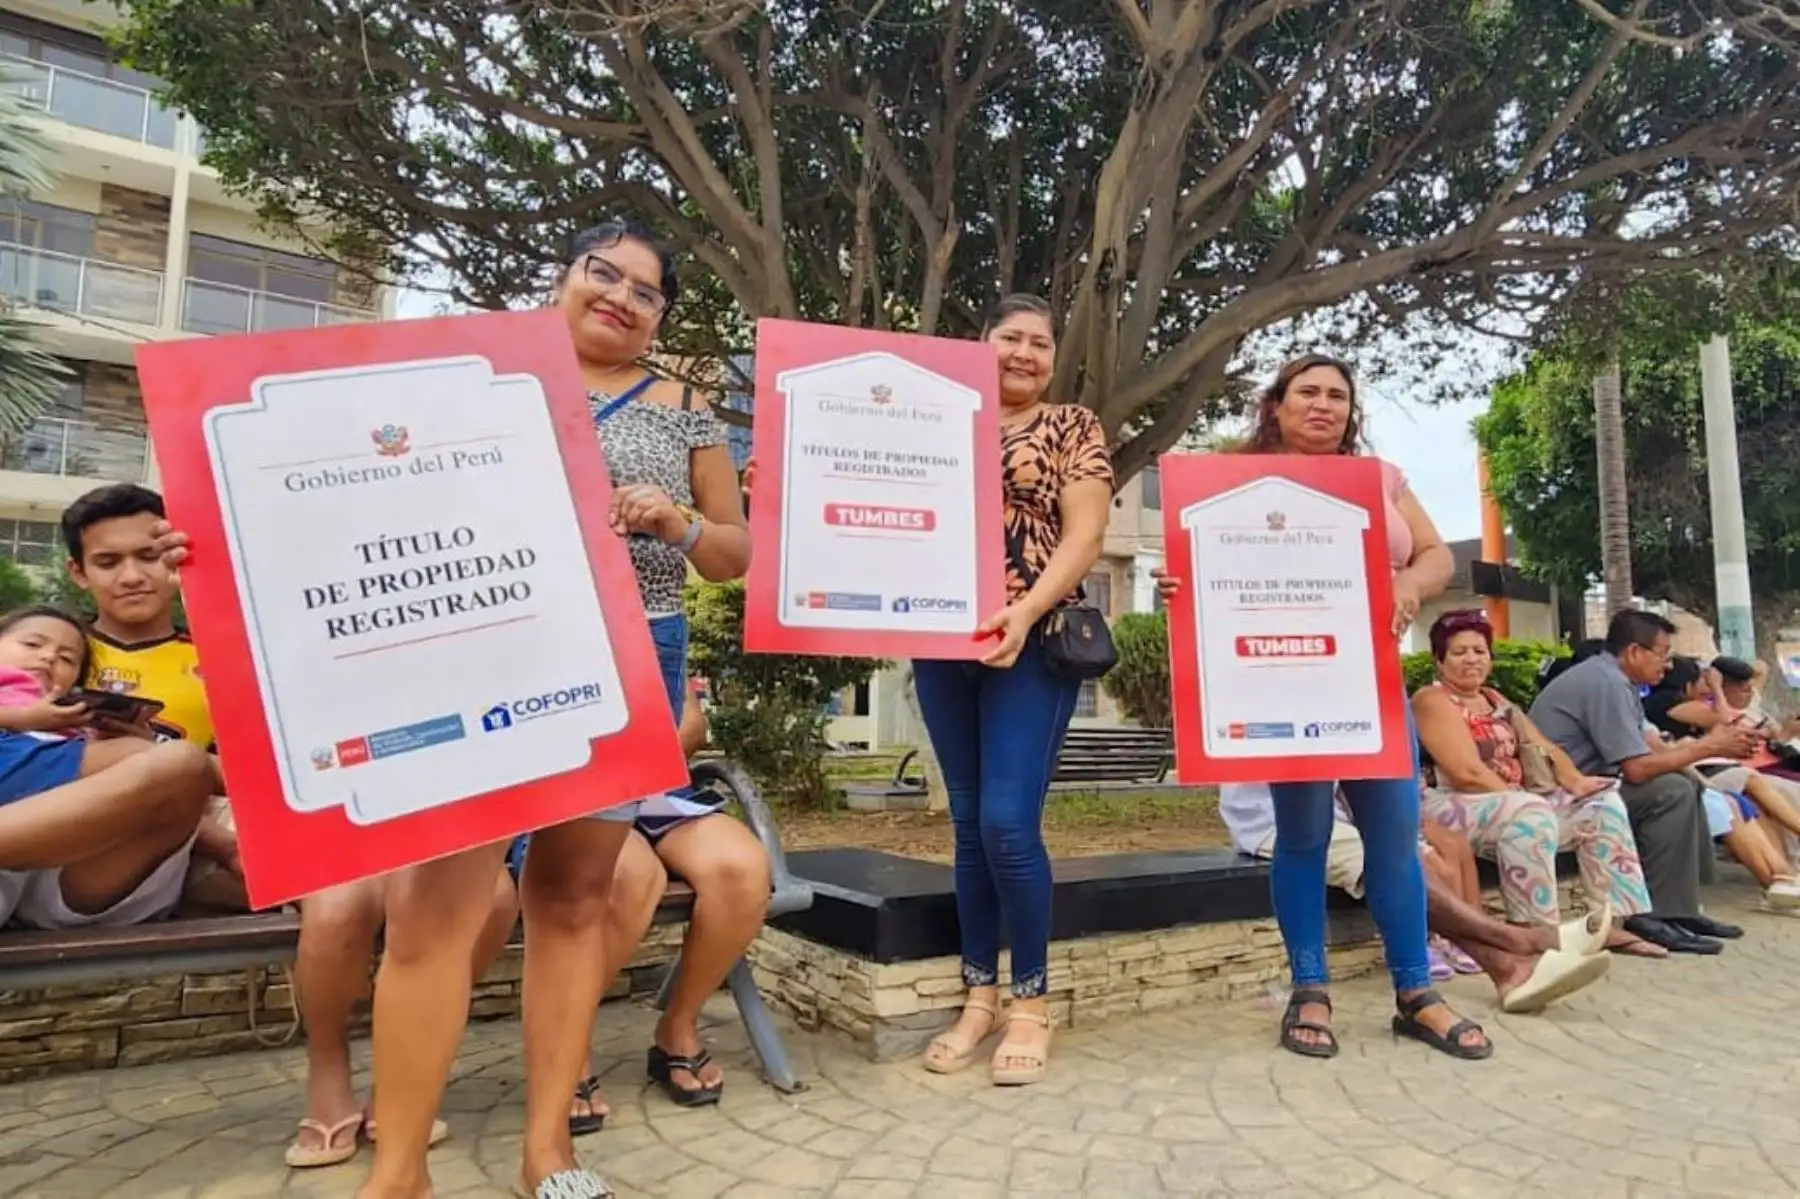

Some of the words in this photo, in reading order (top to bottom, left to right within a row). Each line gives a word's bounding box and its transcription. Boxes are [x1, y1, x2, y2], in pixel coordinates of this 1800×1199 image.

[863, 449, 882, 462] DE
[885, 450, 959, 468] PROPIEDAD
[285, 461, 401, 493] Gobierno
[409, 453, 444, 477] del
[453, 447, 504, 470] Perú
[833, 461, 927, 478] REGISTRADOS
[835, 507, 925, 528] TUMBES
[354, 525, 475, 565] TÍTULO
[302, 581, 349, 610] DE
[357, 547, 537, 599] PROPIEDAD
[1264, 579, 1281, 591] DE
[1239, 591, 1326, 604] REGISTRADOS
[326, 580, 532, 640] REGISTRADO
[1244, 638, 1327, 655] TUMBES
[512, 682, 601, 716] COFOPRI
